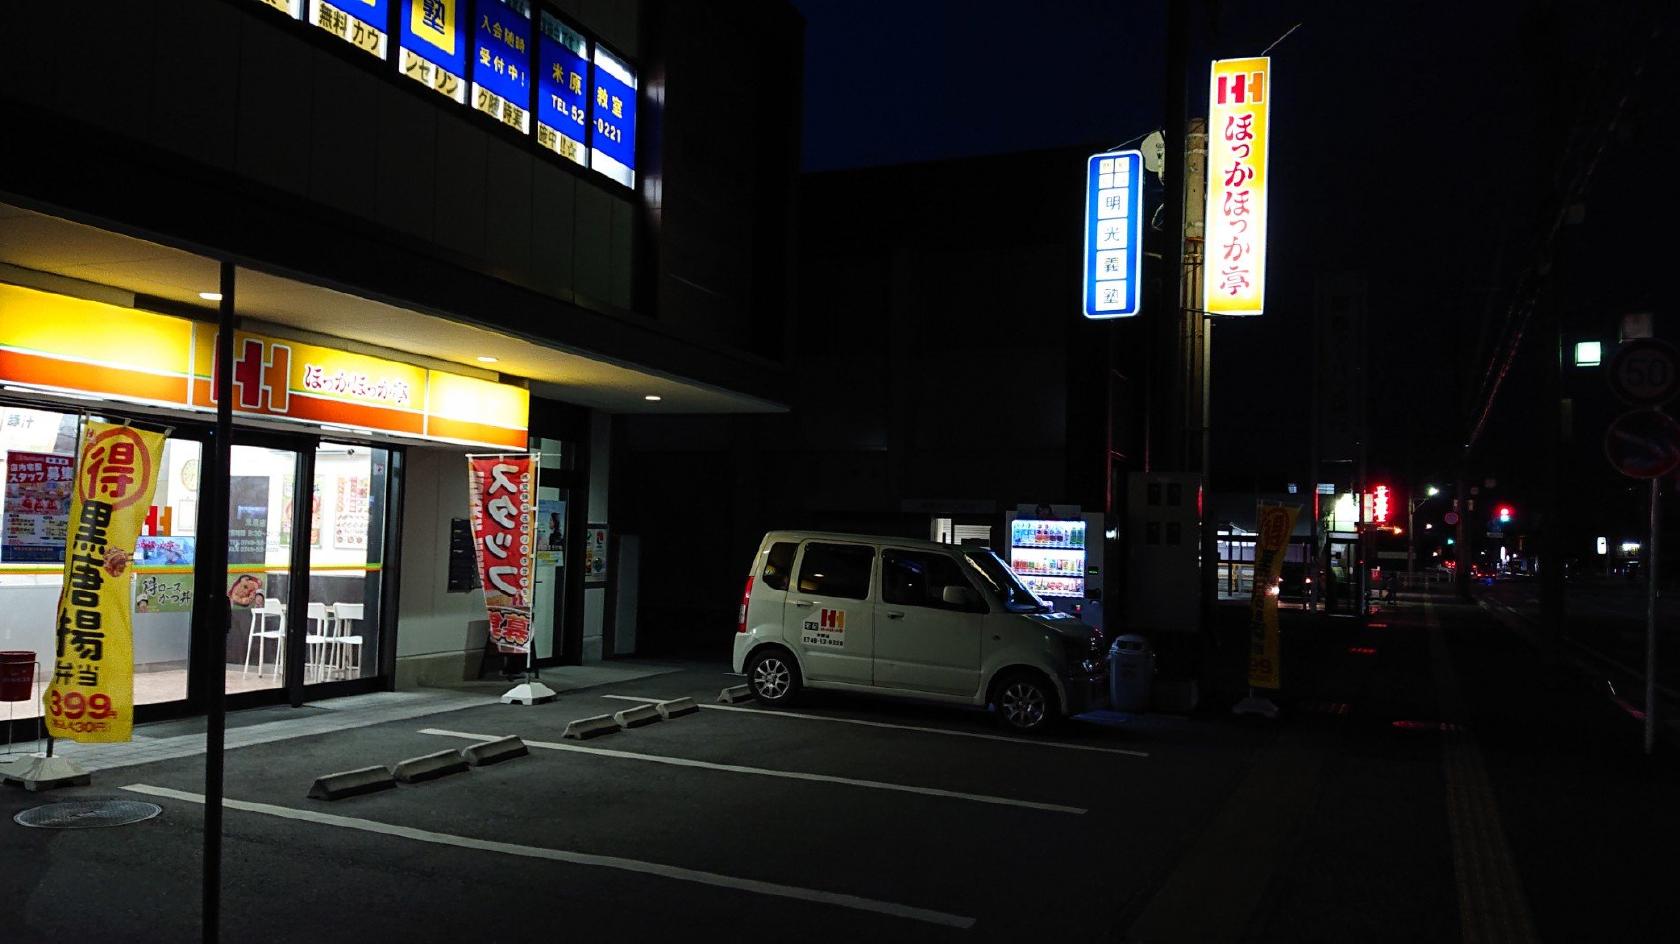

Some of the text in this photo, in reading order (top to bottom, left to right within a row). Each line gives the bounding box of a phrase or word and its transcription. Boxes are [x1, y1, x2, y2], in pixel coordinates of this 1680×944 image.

[481, 15, 525, 53] 入会随時
[552, 95, 568, 116] TEL
[1220, 114, 1253, 295] ほっかほっか亭
[1103, 196, 1121, 304] 明光義塾
[305, 366, 408, 403] ほっかほっか亭
[1627, 359, 1666, 386] 50
[10, 472, 44, 483] スタッフ
[88, 442, 134, 499] 得
[56, 660, 99, 687] 弁当
